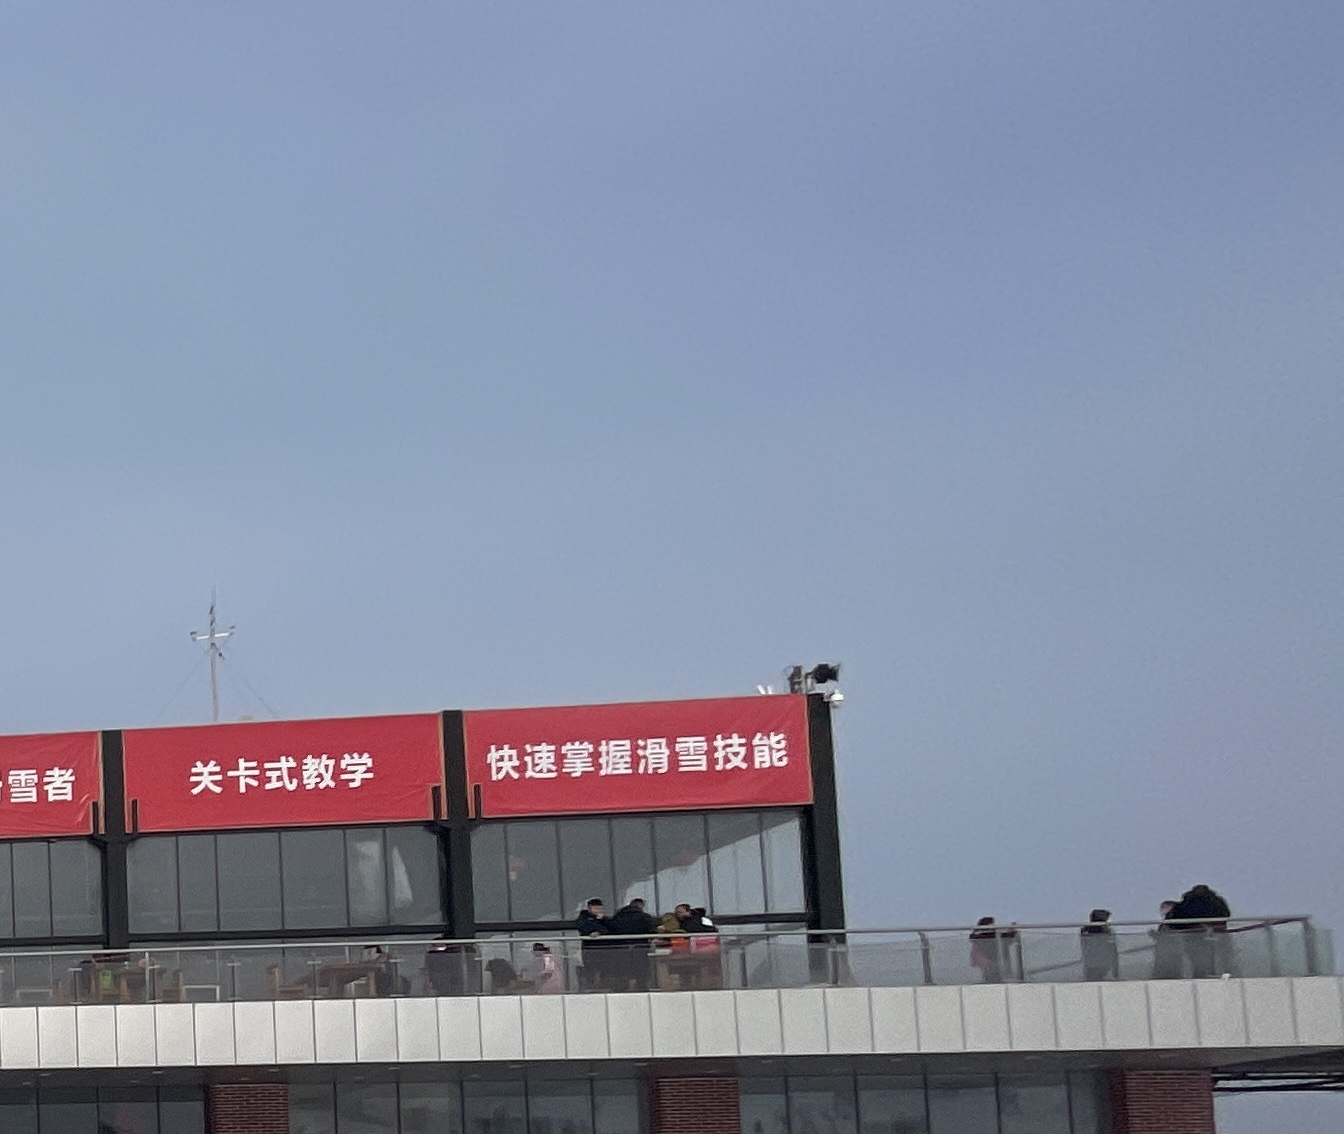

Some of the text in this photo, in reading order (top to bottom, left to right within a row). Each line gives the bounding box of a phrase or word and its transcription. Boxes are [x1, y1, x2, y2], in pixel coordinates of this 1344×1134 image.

[189, 752, 375, 795] 关卡式教学
[486, 732, 790, 781] 快速掌握滑雪技能
